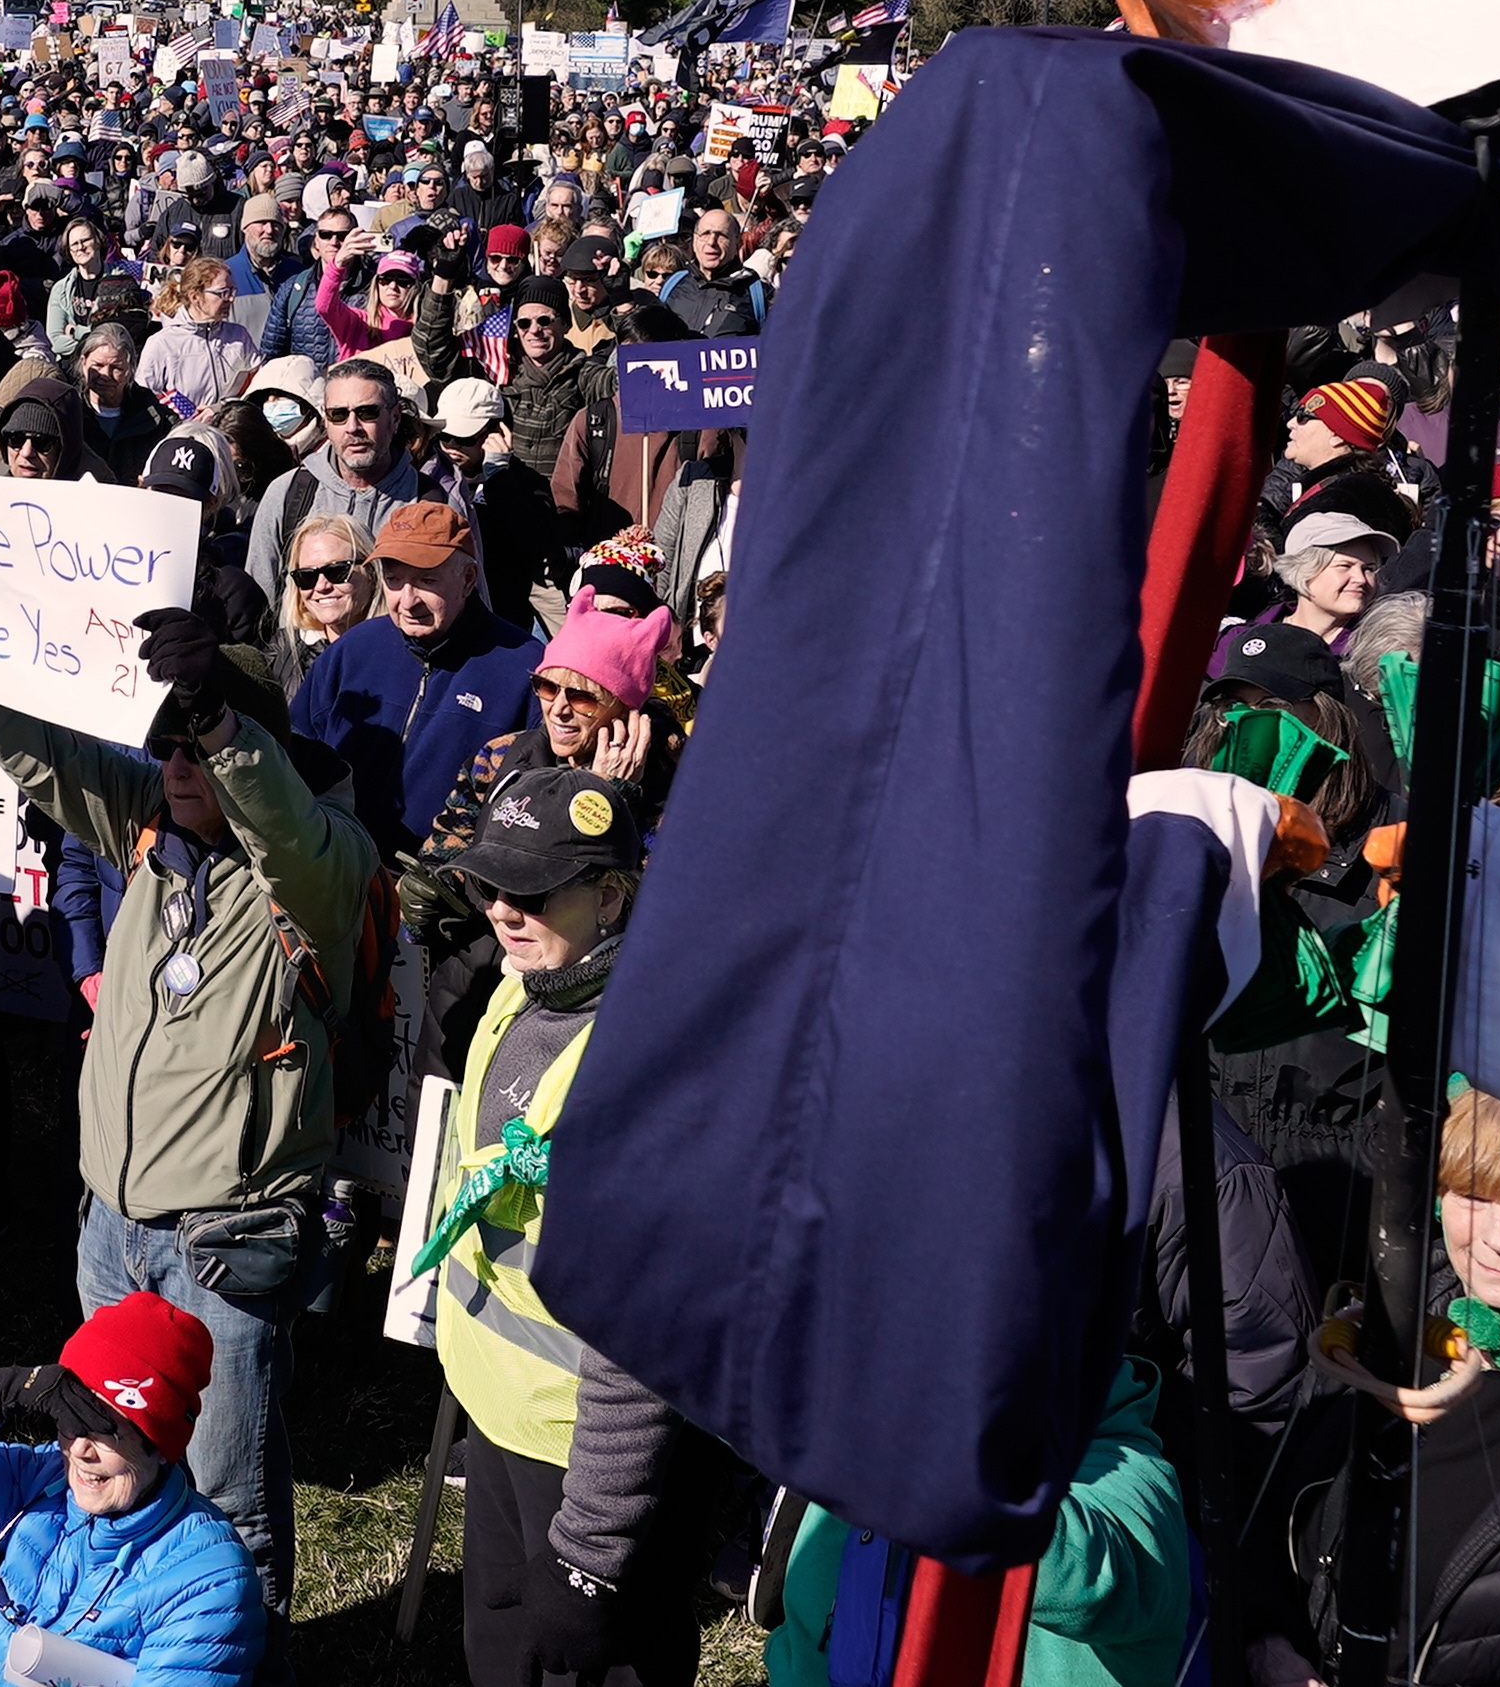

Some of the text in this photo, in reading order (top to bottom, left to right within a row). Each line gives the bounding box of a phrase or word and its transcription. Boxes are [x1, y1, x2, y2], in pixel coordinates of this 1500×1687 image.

[699, 347, 757, 372] INDI
[10, 502, 171, 587] Power
[20, 604, 82, 676] Yes
[111, 663, 138, 699] 21
